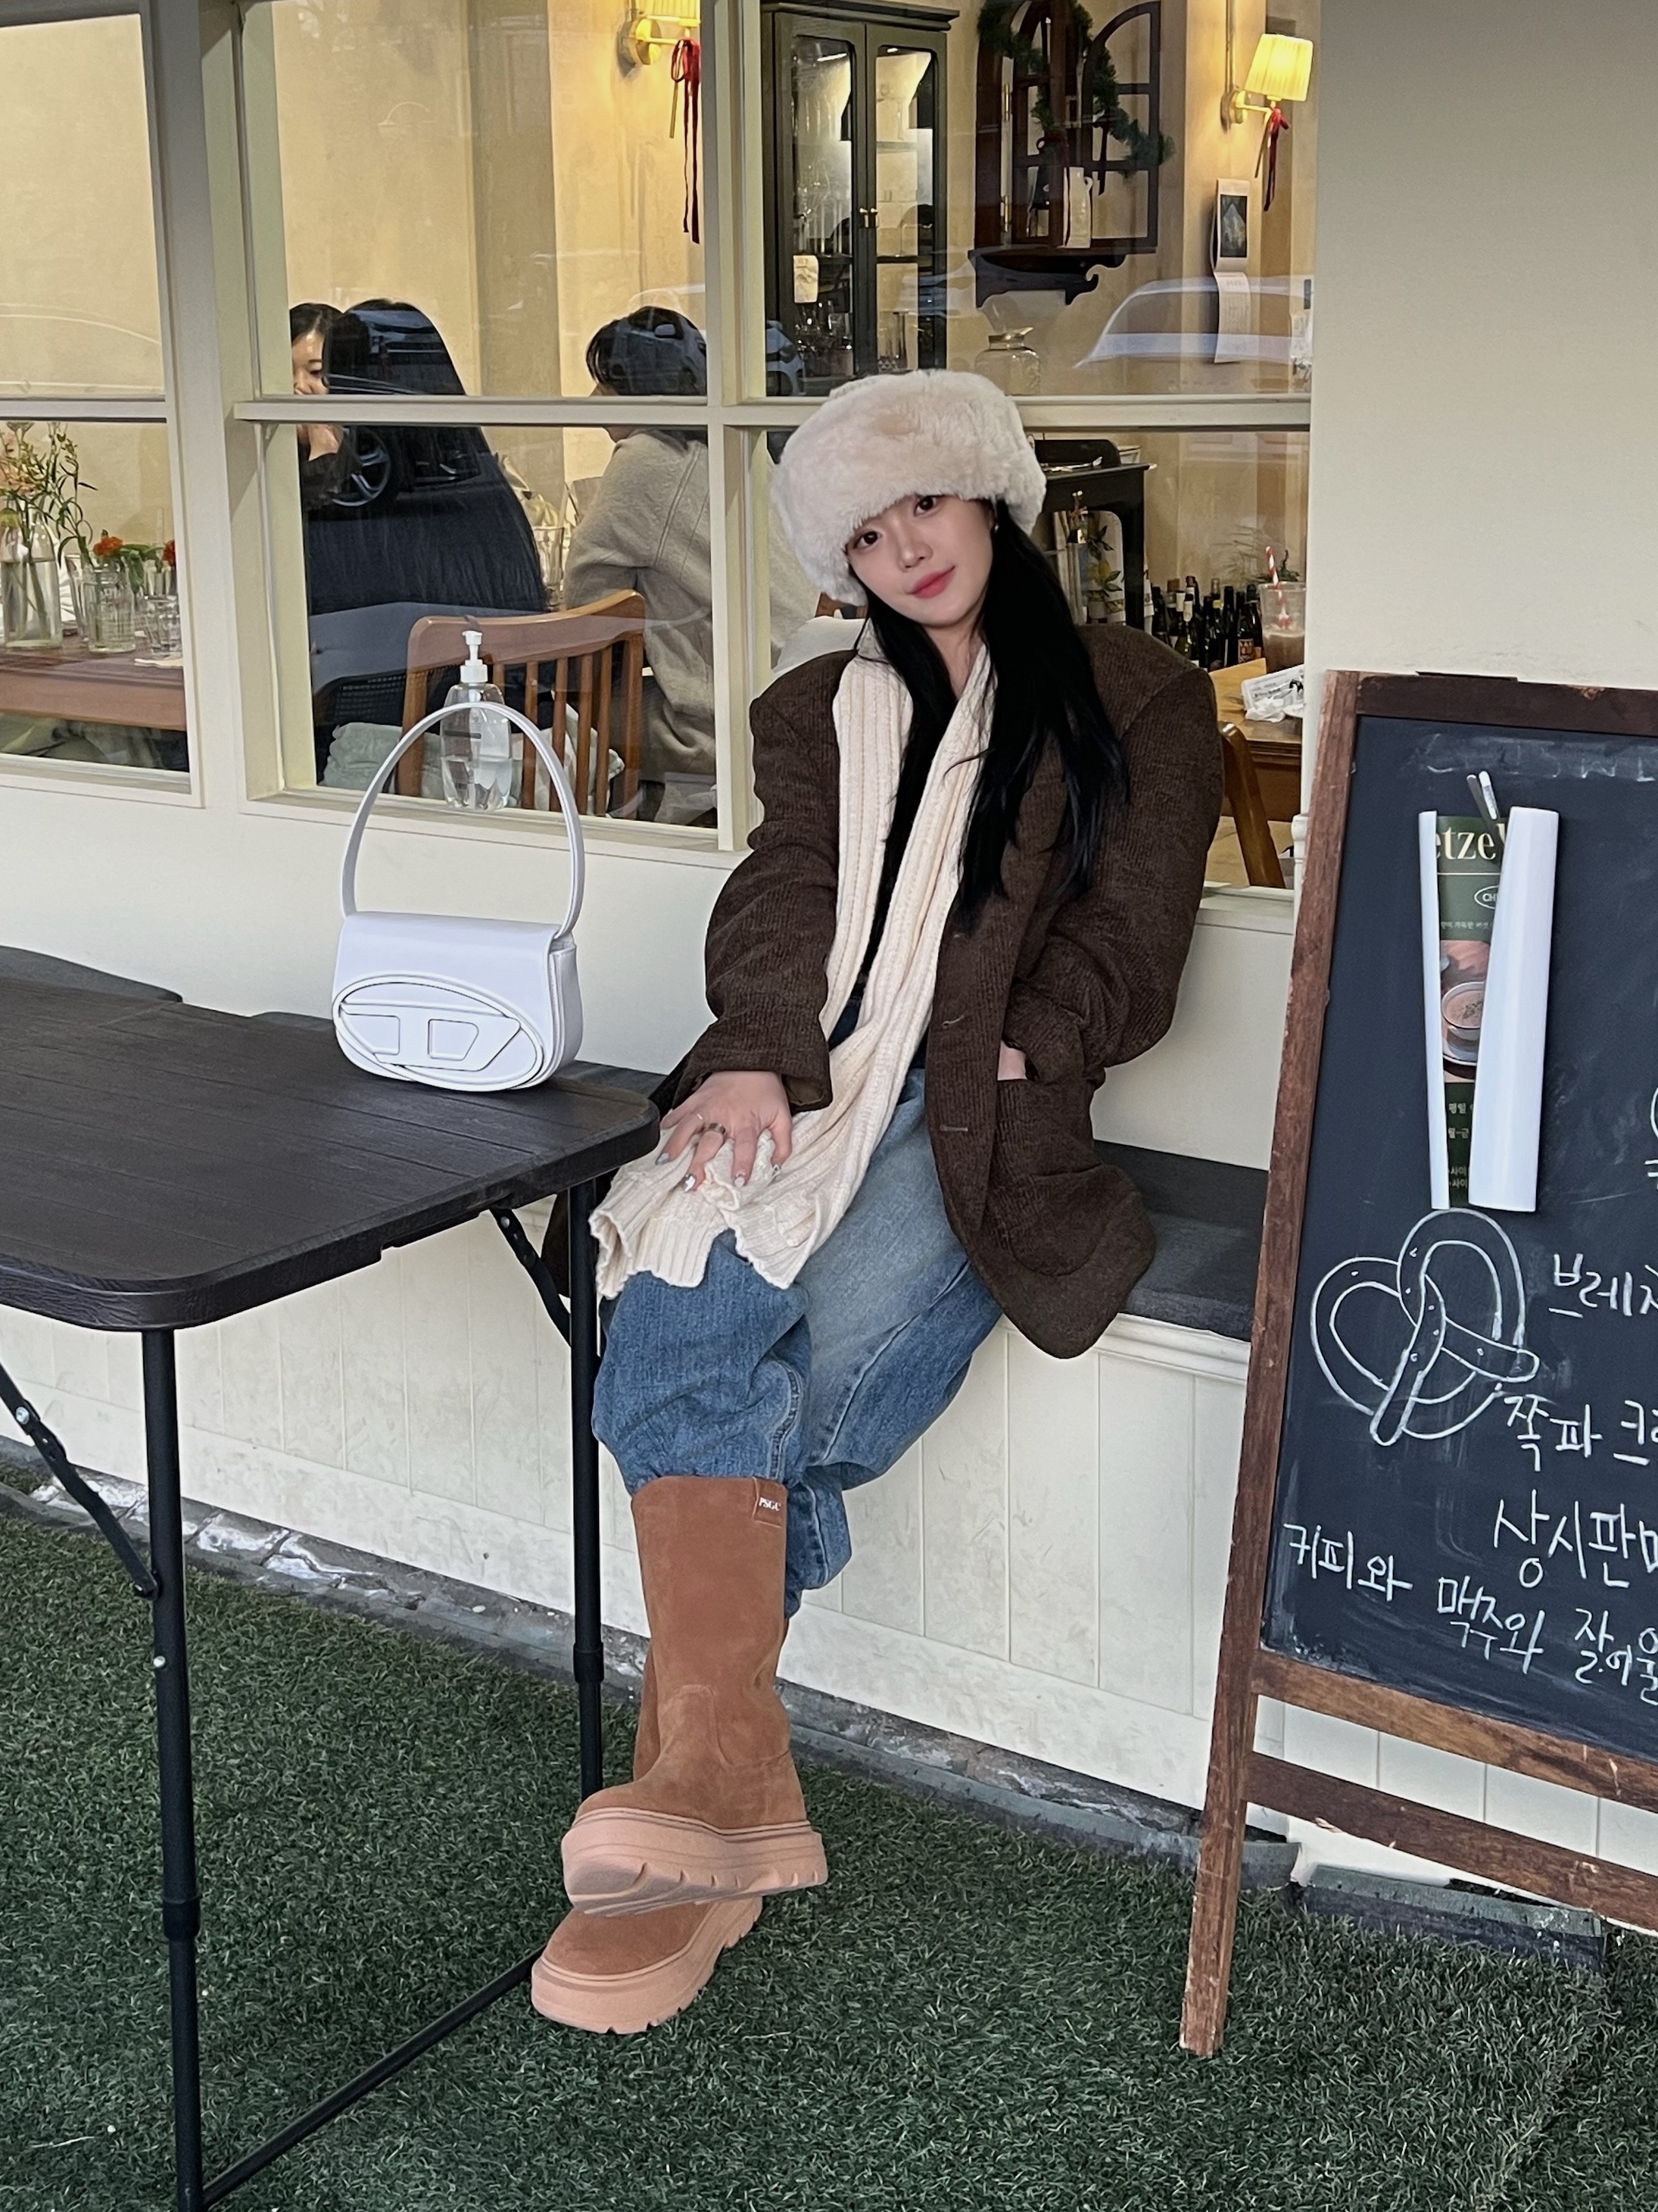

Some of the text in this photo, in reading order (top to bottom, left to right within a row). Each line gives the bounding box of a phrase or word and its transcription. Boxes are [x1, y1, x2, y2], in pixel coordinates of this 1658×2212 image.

[1482, 893, 1497, 902] CH
[1613, 1399, 1658, 1466] 크
[1284, 1523, 1413, 1602] 커피와
[1437, 1575, 1545, 1674] 맥주와
